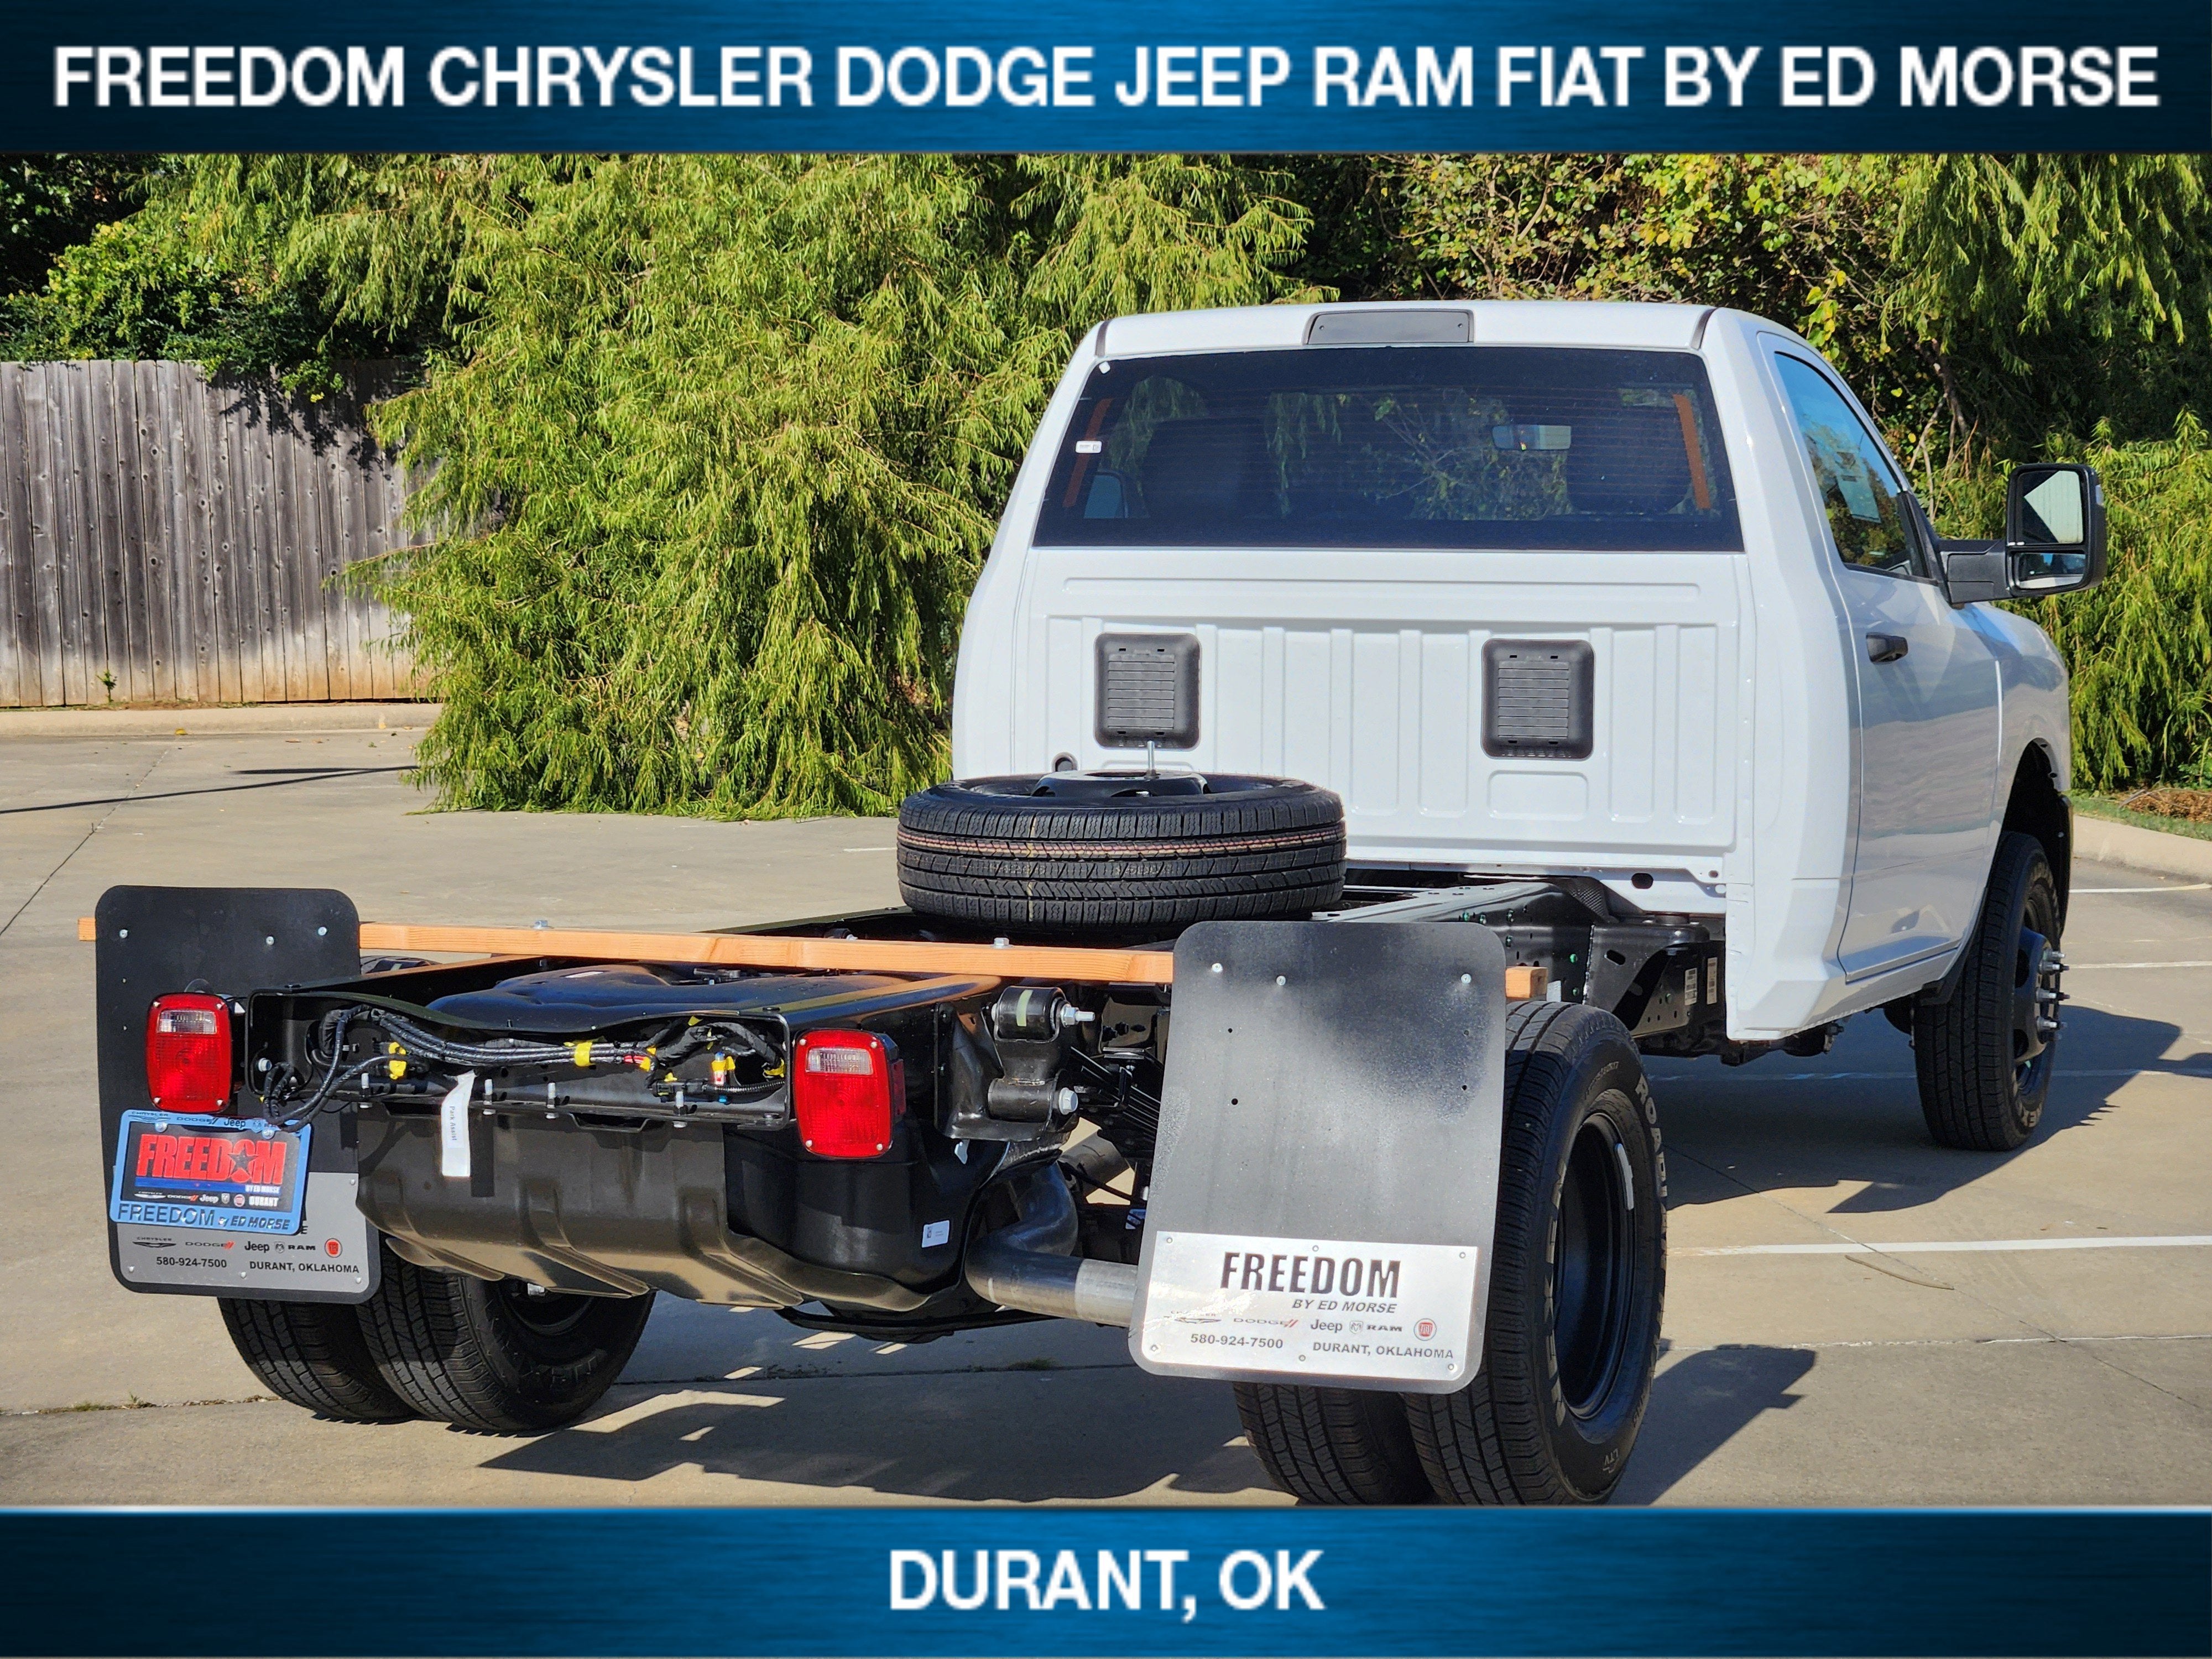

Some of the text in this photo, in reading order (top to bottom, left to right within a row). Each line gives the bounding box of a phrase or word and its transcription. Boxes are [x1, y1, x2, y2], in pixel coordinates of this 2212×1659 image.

[224, 1118, 246, 1128] Jeep
[137, 1134, 286, 1185] FREEDOM
[200, 1194, 219, 1203] Jeep
[249, 1196, 279, 1207] DURANT
[118, 1203, 215, 1227] FREEDOM
[231, 1215, 247, 1227] ED
[248, 1217, 290, 1229] MORSE
[244, 1241, 270, 1253] Jeep
[156, 1257, 227, 1268] 580-924-7500
[249, 1261, 359, 1273] DURANT, OKLAHOMA
[1220, 1251, 1401, 1299] FREEDOM
[1292, 1299, 1397, 1314] BY ED MORSE
[1311, 1319, 1343, 1332] Jeep
[1191, 1333, 1284, 1349] 580-924-7500
[1313, 1342, 1453, 1359] DURANT, OKLAHOMA
